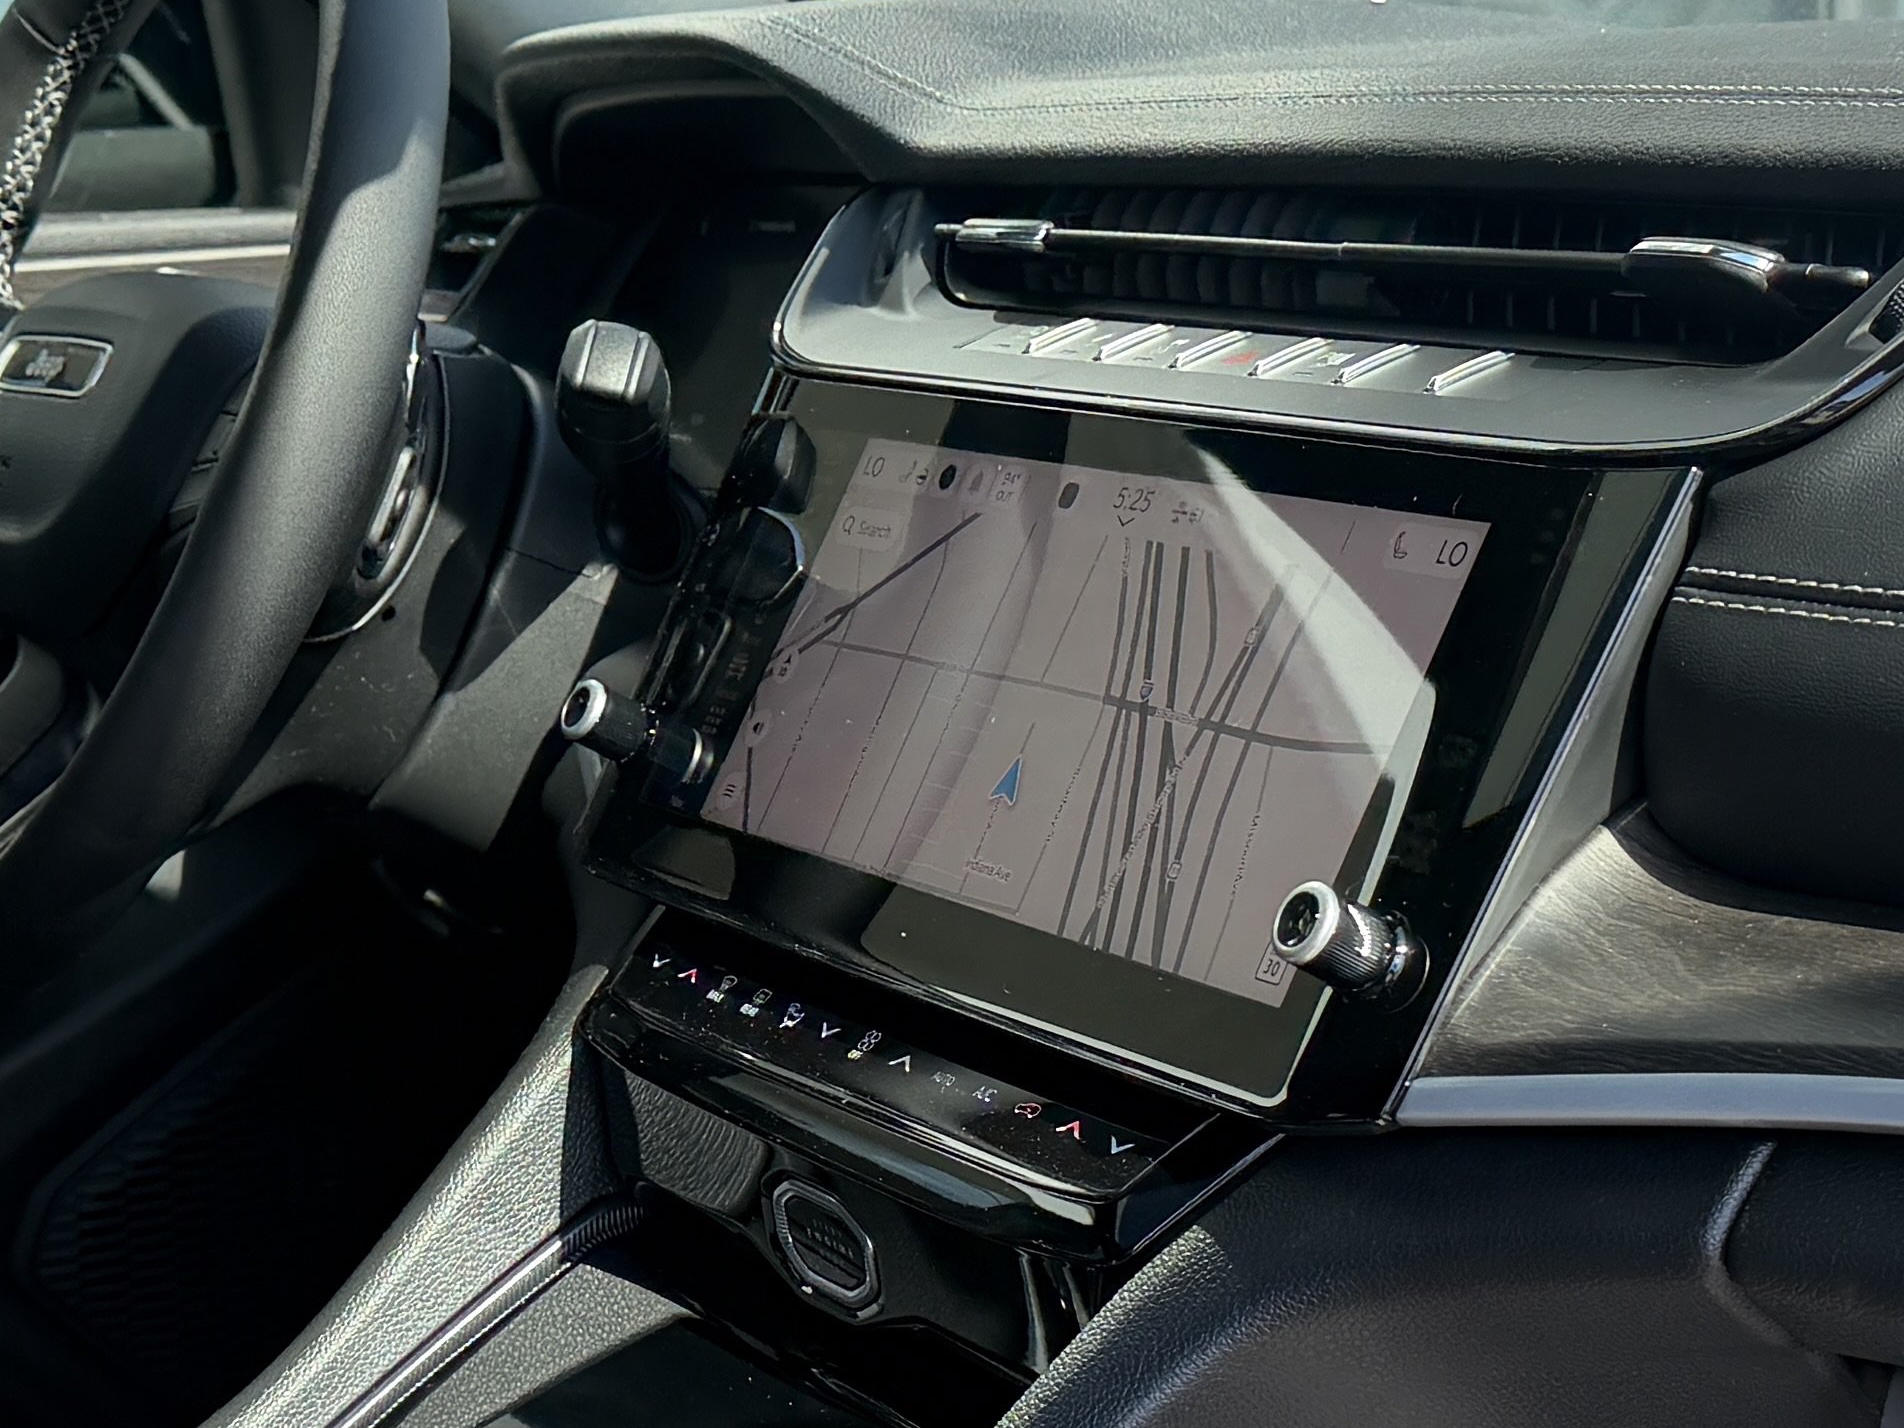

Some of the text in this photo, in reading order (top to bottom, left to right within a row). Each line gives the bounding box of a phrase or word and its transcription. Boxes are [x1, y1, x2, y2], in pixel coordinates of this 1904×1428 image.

[864, 456, 885, 478] LO
[1112, 486, 1156, 513] 5:25
[1436, 538, 1469, 568] LO
[1261, 957, 1283, 979] 30
